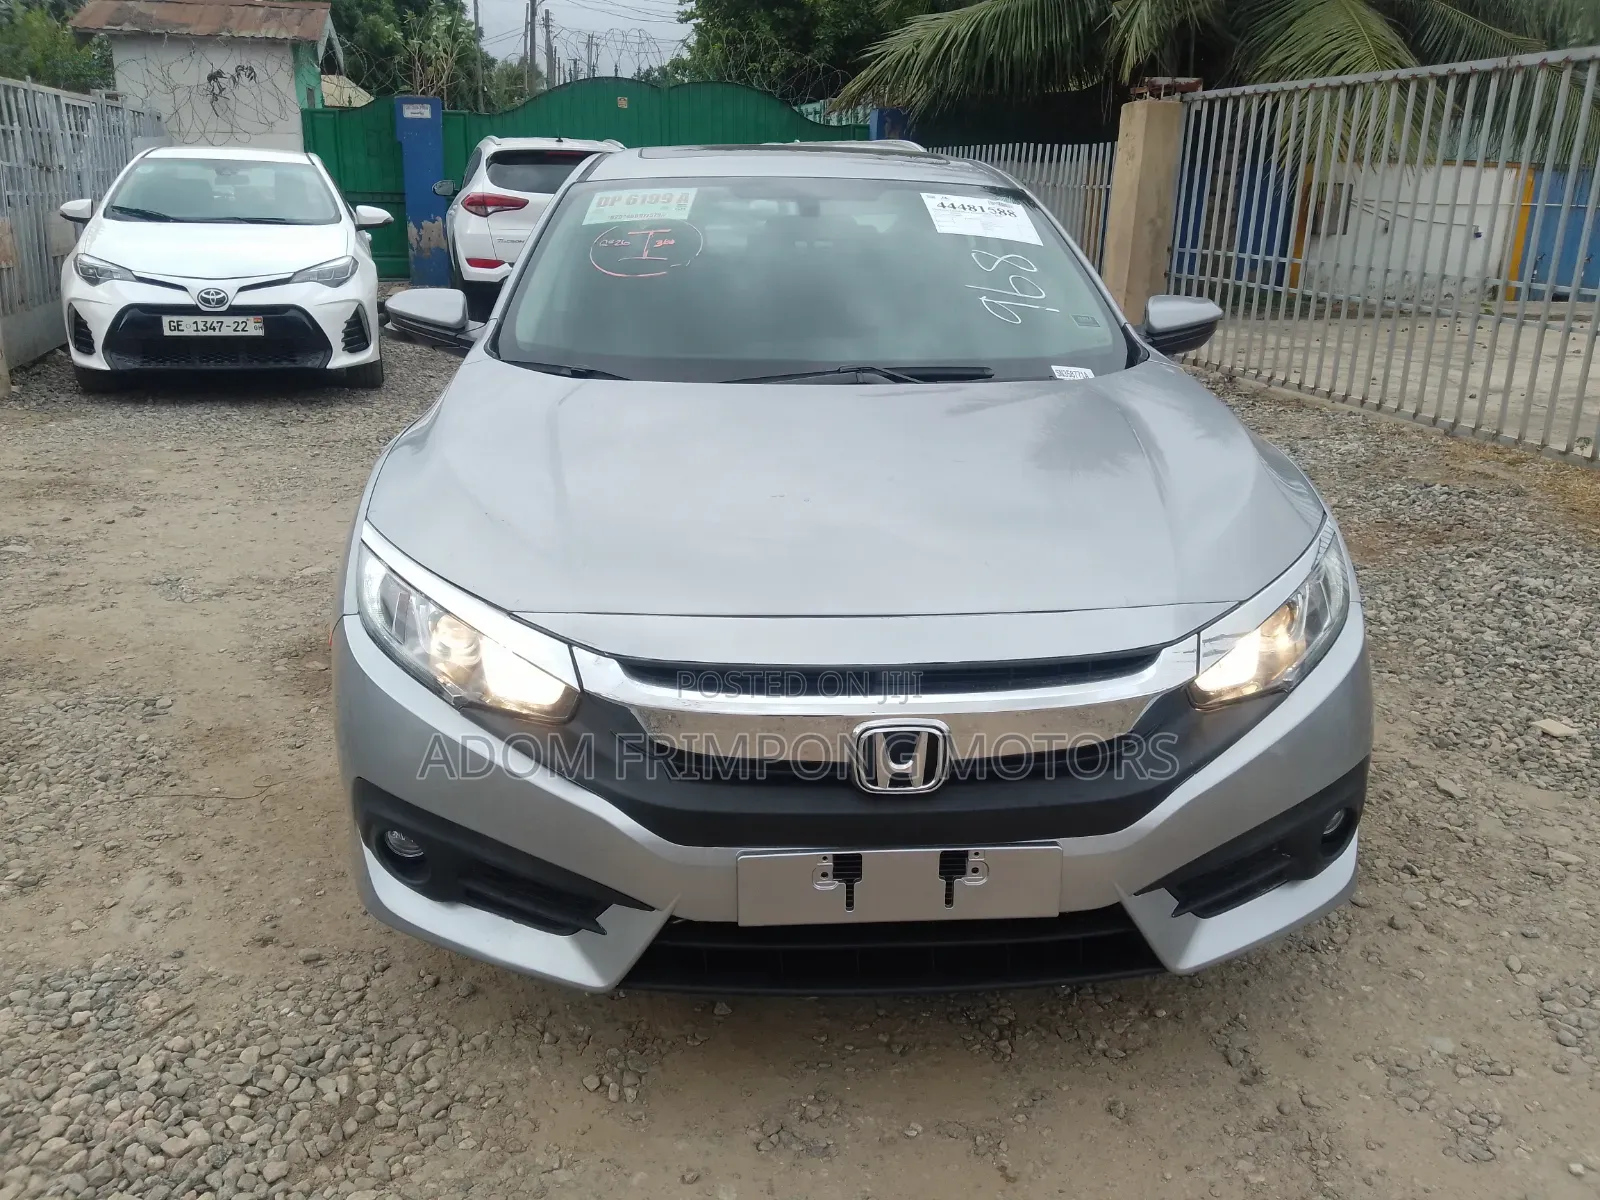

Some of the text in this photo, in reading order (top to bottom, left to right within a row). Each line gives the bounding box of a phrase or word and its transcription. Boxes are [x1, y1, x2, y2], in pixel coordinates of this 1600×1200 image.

[595, 195, 622, 208] DP
[625, 192, 674, 206] 6199
[937, 201, 1018, 218] 44481588
[964, 249, 1060, 325] 968
[168, 319, 248, 333] GE 1347-22
